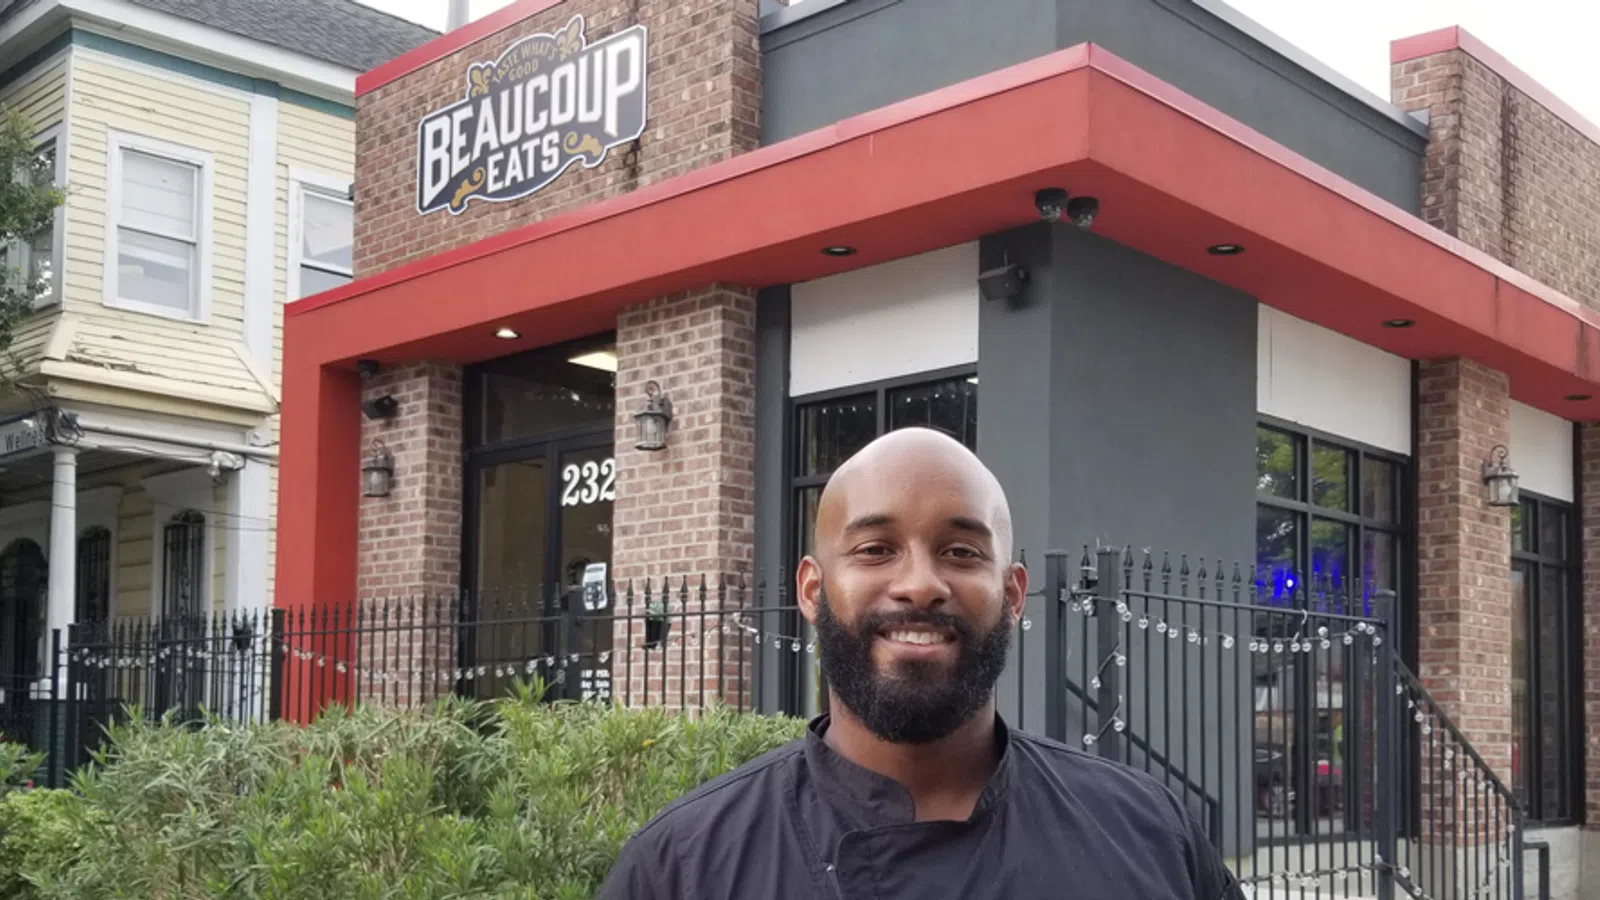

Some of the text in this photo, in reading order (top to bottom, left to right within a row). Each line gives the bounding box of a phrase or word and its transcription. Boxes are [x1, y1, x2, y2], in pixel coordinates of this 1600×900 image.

[491, 41, 558, 83] TASTE WHAT'S
[508, 59, 539, 81] GOOD
[423, 36, 641, 207] BEAUCOUP
[487, 131, 560, 193] EATS
[4, 430, 46, 451] Wellnes
[561, 458, 616, 506] 232
